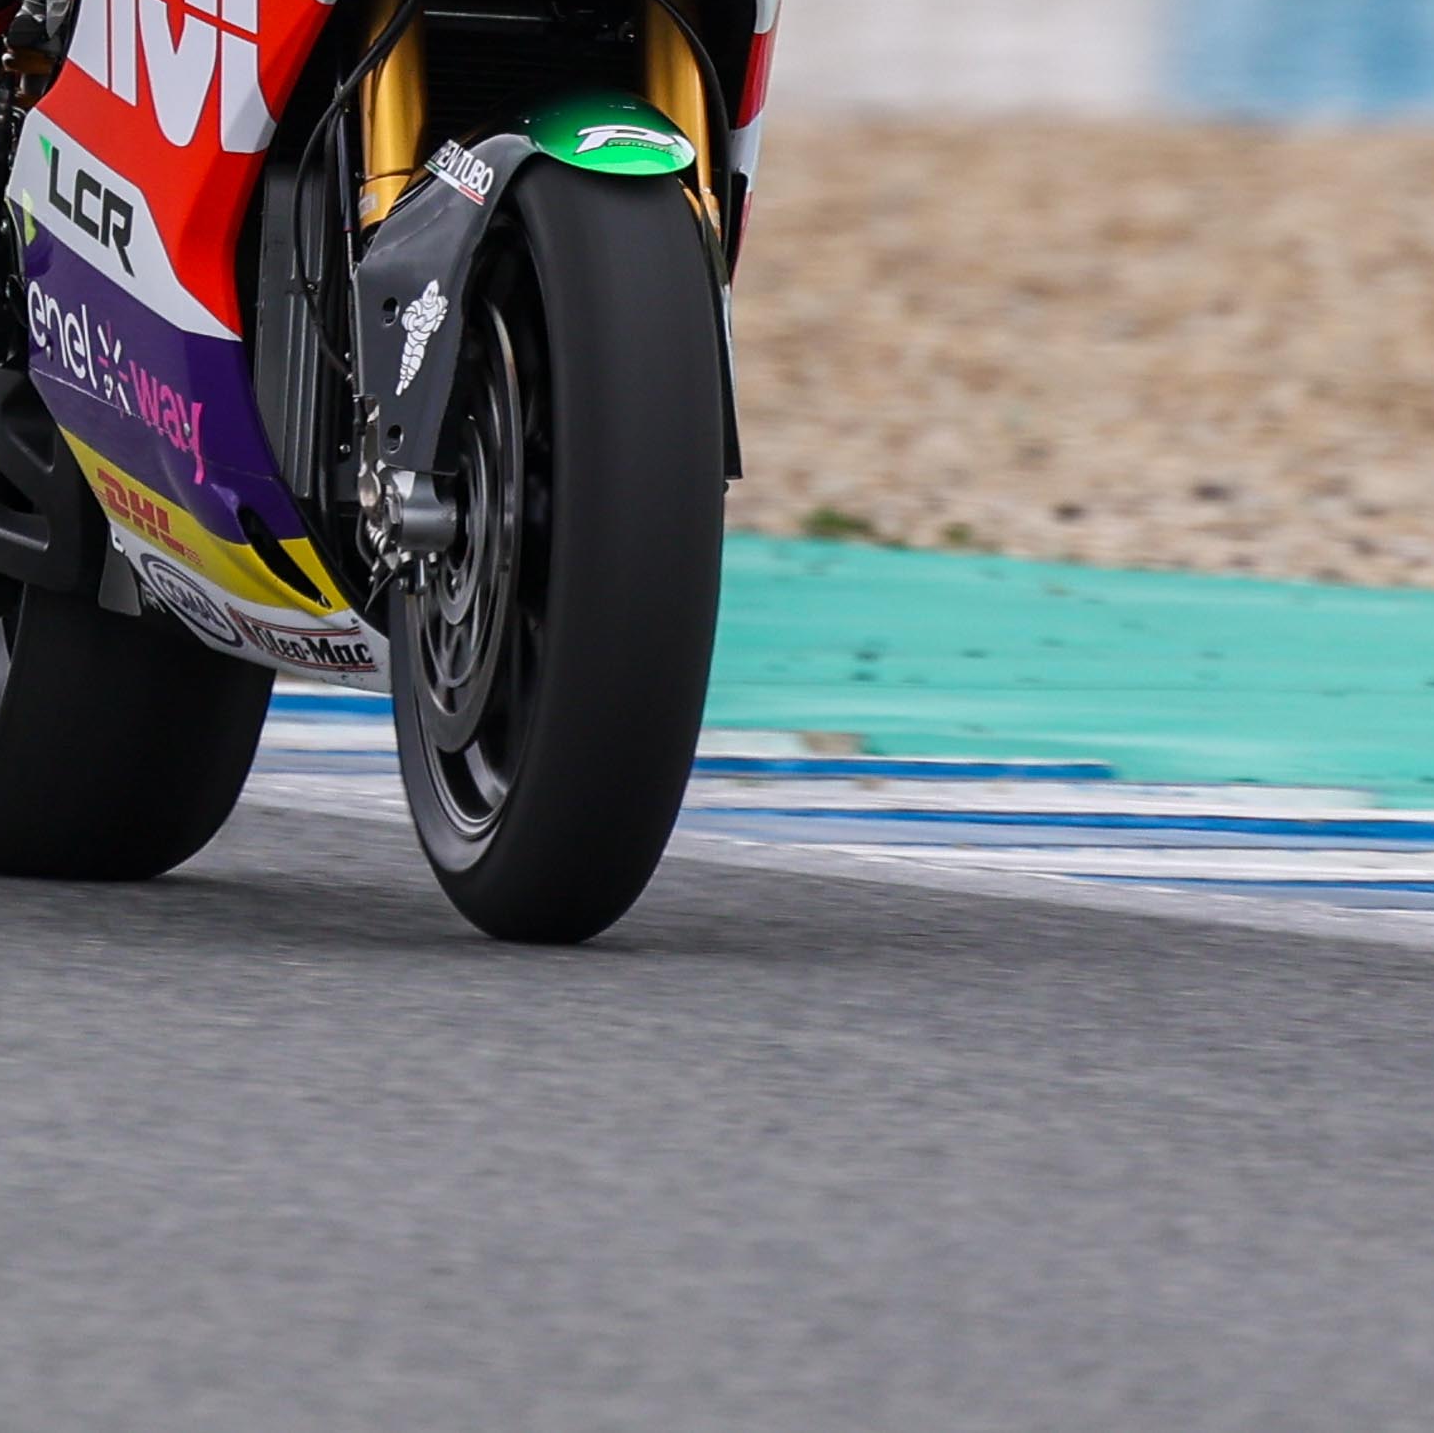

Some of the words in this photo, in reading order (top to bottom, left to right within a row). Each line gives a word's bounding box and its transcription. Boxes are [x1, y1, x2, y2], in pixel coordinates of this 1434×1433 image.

[48, 146, 135, 277] LCR
[460, 149, 494, 195] TUBO
[27, 280, 97, 392] enel
[130, 361, 204, 484] way
[97, 467, 186, 556] DHL
